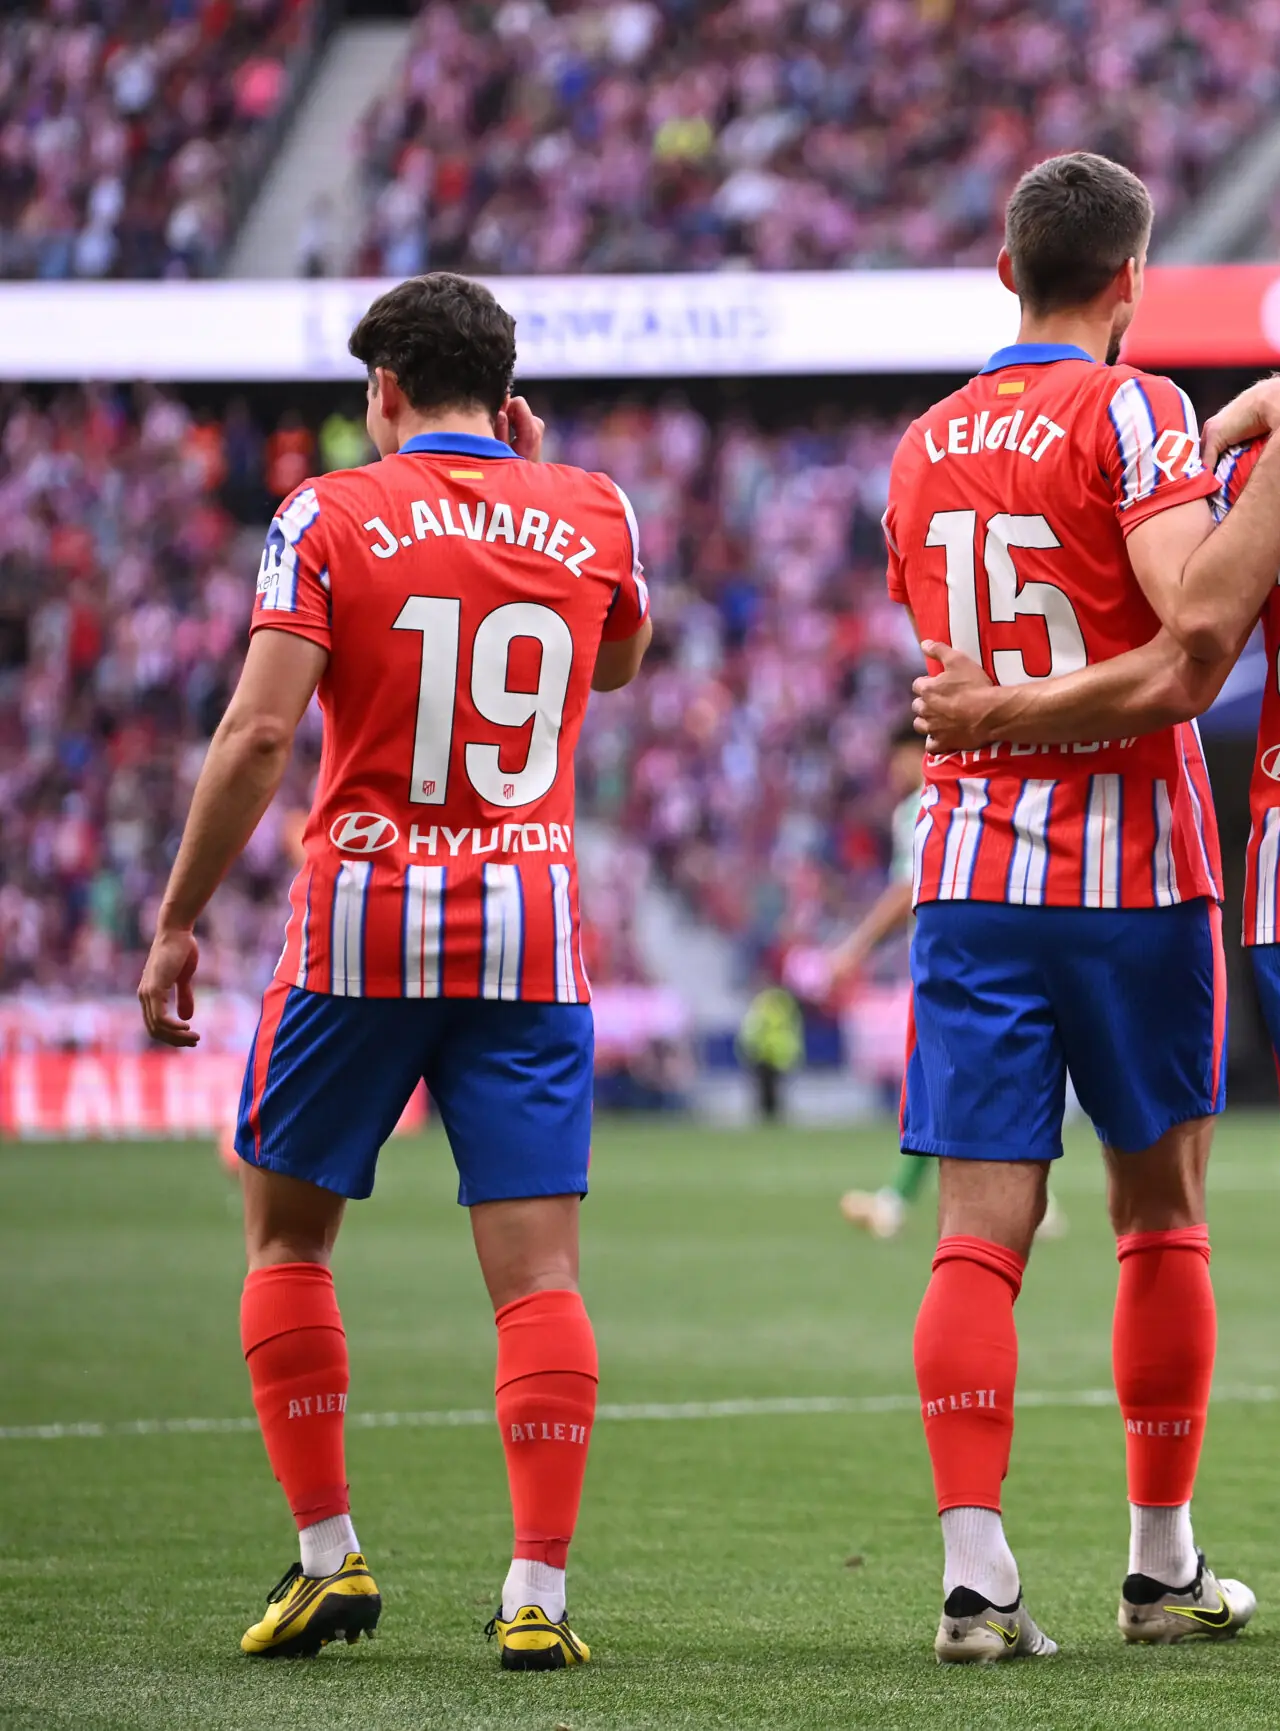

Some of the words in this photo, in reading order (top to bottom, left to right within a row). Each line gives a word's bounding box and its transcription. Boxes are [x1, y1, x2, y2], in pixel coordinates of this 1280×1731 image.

[924, 409, 1066, 464] LENGLET
[363, 498, 597, 578] J.ALVAREZ
[924, 509, 1089, 688] 15
[391, 594, 574, 808] 19
[927, 1389, 996, 1417] ATLETI
[1126, 1418, 1191, 1436] ATLETI
[511, 1422, 586, 1444] ATLETI
